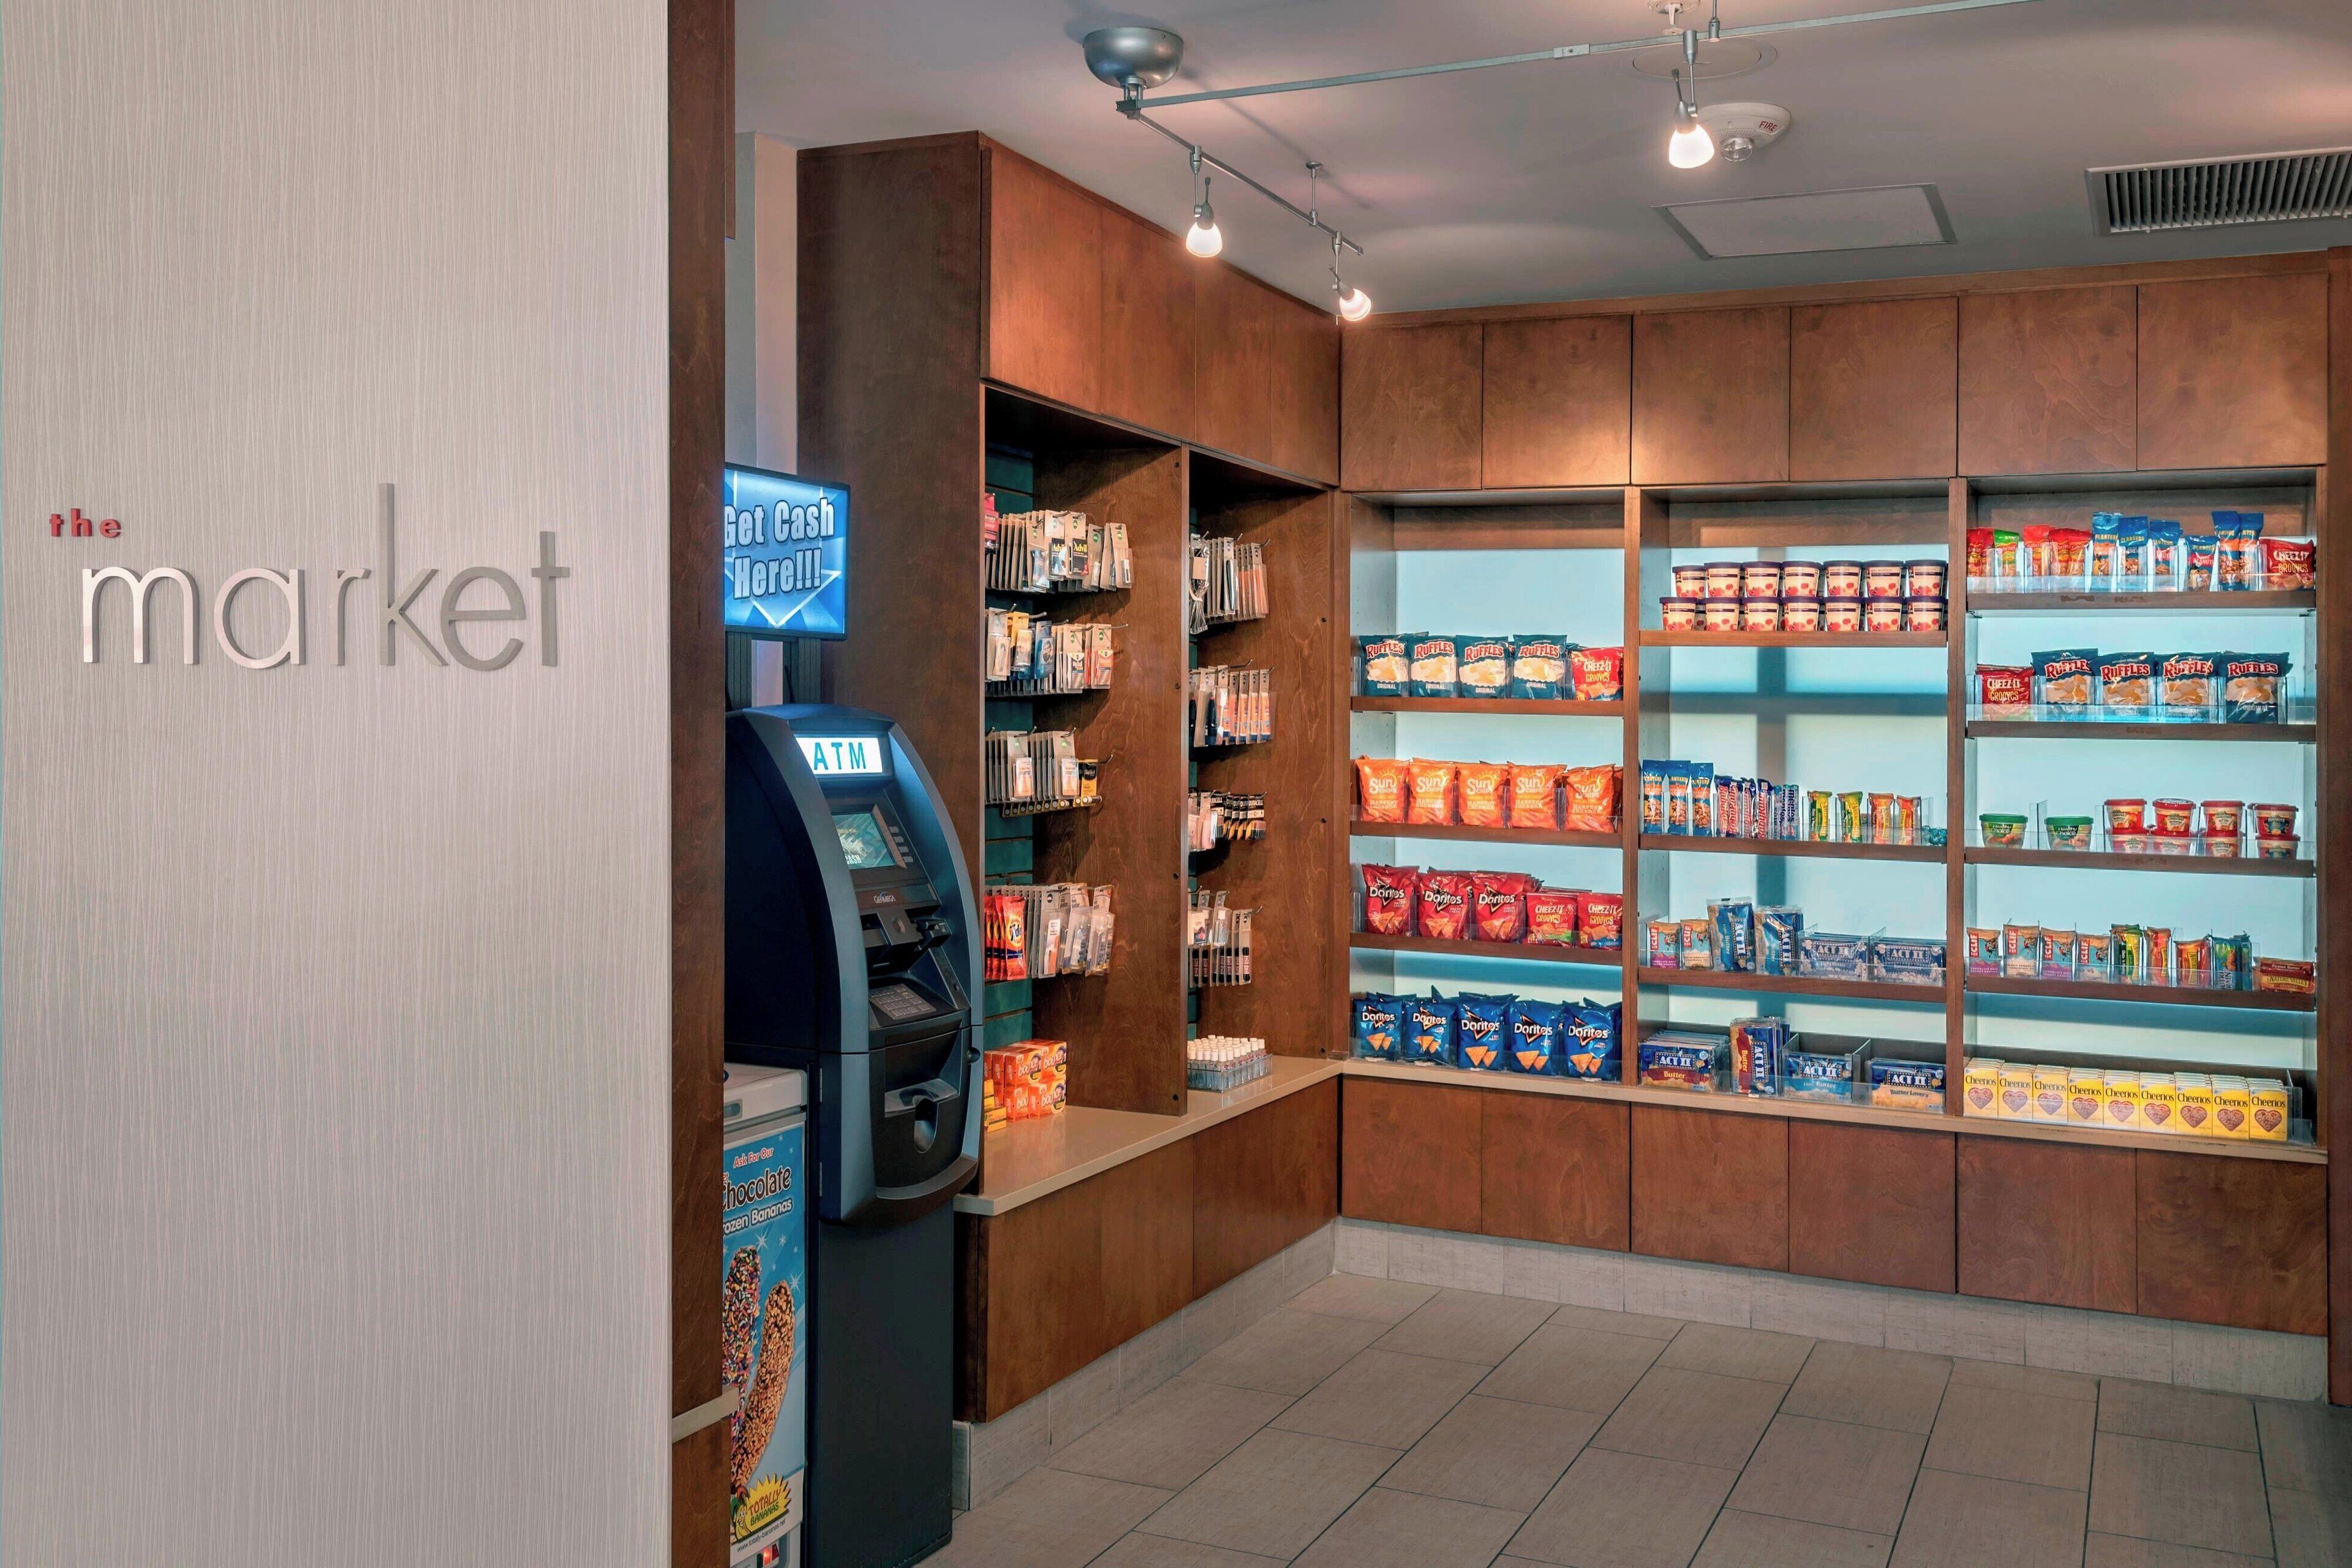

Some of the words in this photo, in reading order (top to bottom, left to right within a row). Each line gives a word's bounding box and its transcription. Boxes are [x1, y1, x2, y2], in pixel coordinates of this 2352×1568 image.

[49, 508, 122, 538] the
[773, 497, 834, 543] Cash
[82, 483, 570, 671] market
[733, 548, 822, 600] Here!!!
[1415, 641, 1453, 658] RUFFLES
[1464, 645, 1504, 661] RUFFLES
[1518, 644, 1559, 658] RUFFLES
[2100, 663, 2149, 681] RUFFLES
[2163, 660, 2213, 679] RUFFLES
[2228, 662, 2278, 677] RUFFLES
[814, 742, 866, 770] ATM
[1370, 888, 1404, 898] Doritos
[1425, 891, 1462, 904] Doritos
[1479, 894, 1515, 904] Doritos
[1892, 949, 1910, 958] ACT
[1912, 950, 1923, 959] II
[1362, 1012, 1395, 1021] Doritos
[1412, 1013, 1446, 1025] Doritos
[1461, 1019, 1500, 1031] Doritos
[1514, 1023, 1553, 1036] Doritos
[1568, 1025, 1608, 1039] Doritos
[1659, 1055, 1678, 1066] ACT
[1679, 1058, 1691, 1066] II
[1754, 1046, 1764, 1066] ACT
[1804, 1066, 1824, 1076] ACT
[1826, 1068, 1837, 1077] II
[1891, 1074, 1913, 1084] ACT
[1915, 1076, 1926, 1085] II
[1965, 1076, 1996, 1086] Cheerios
[1999, 1078, 2030, 1089] Cheerios
[2035, 1080, 2066, 1091] Cheerios
[2070, 1084, 2101, 1096] Cheerios
[2105, 1087, 2138, 1098] Cheerios
[2141, 1090, 2174, 1101] Cheerios
[2177, 1093, 2211, 1104] Cheerios
[2214, 1096, 2248, 1107] Cheerios
[2252, 1096, 2286, 1108] Cheerios
[733, 1153, 747, 1168] Ask
[748, 1152, 760, 1164] For
[760, 1147, 774, 1158] Our
[1074, 1156, 1087, 1164] Advil
[752, 1199, 792, 1224] Bananas
[748, 1489, 782, 1516] TOTALLY
[750, 1502, 779, 1526] BANANAS
